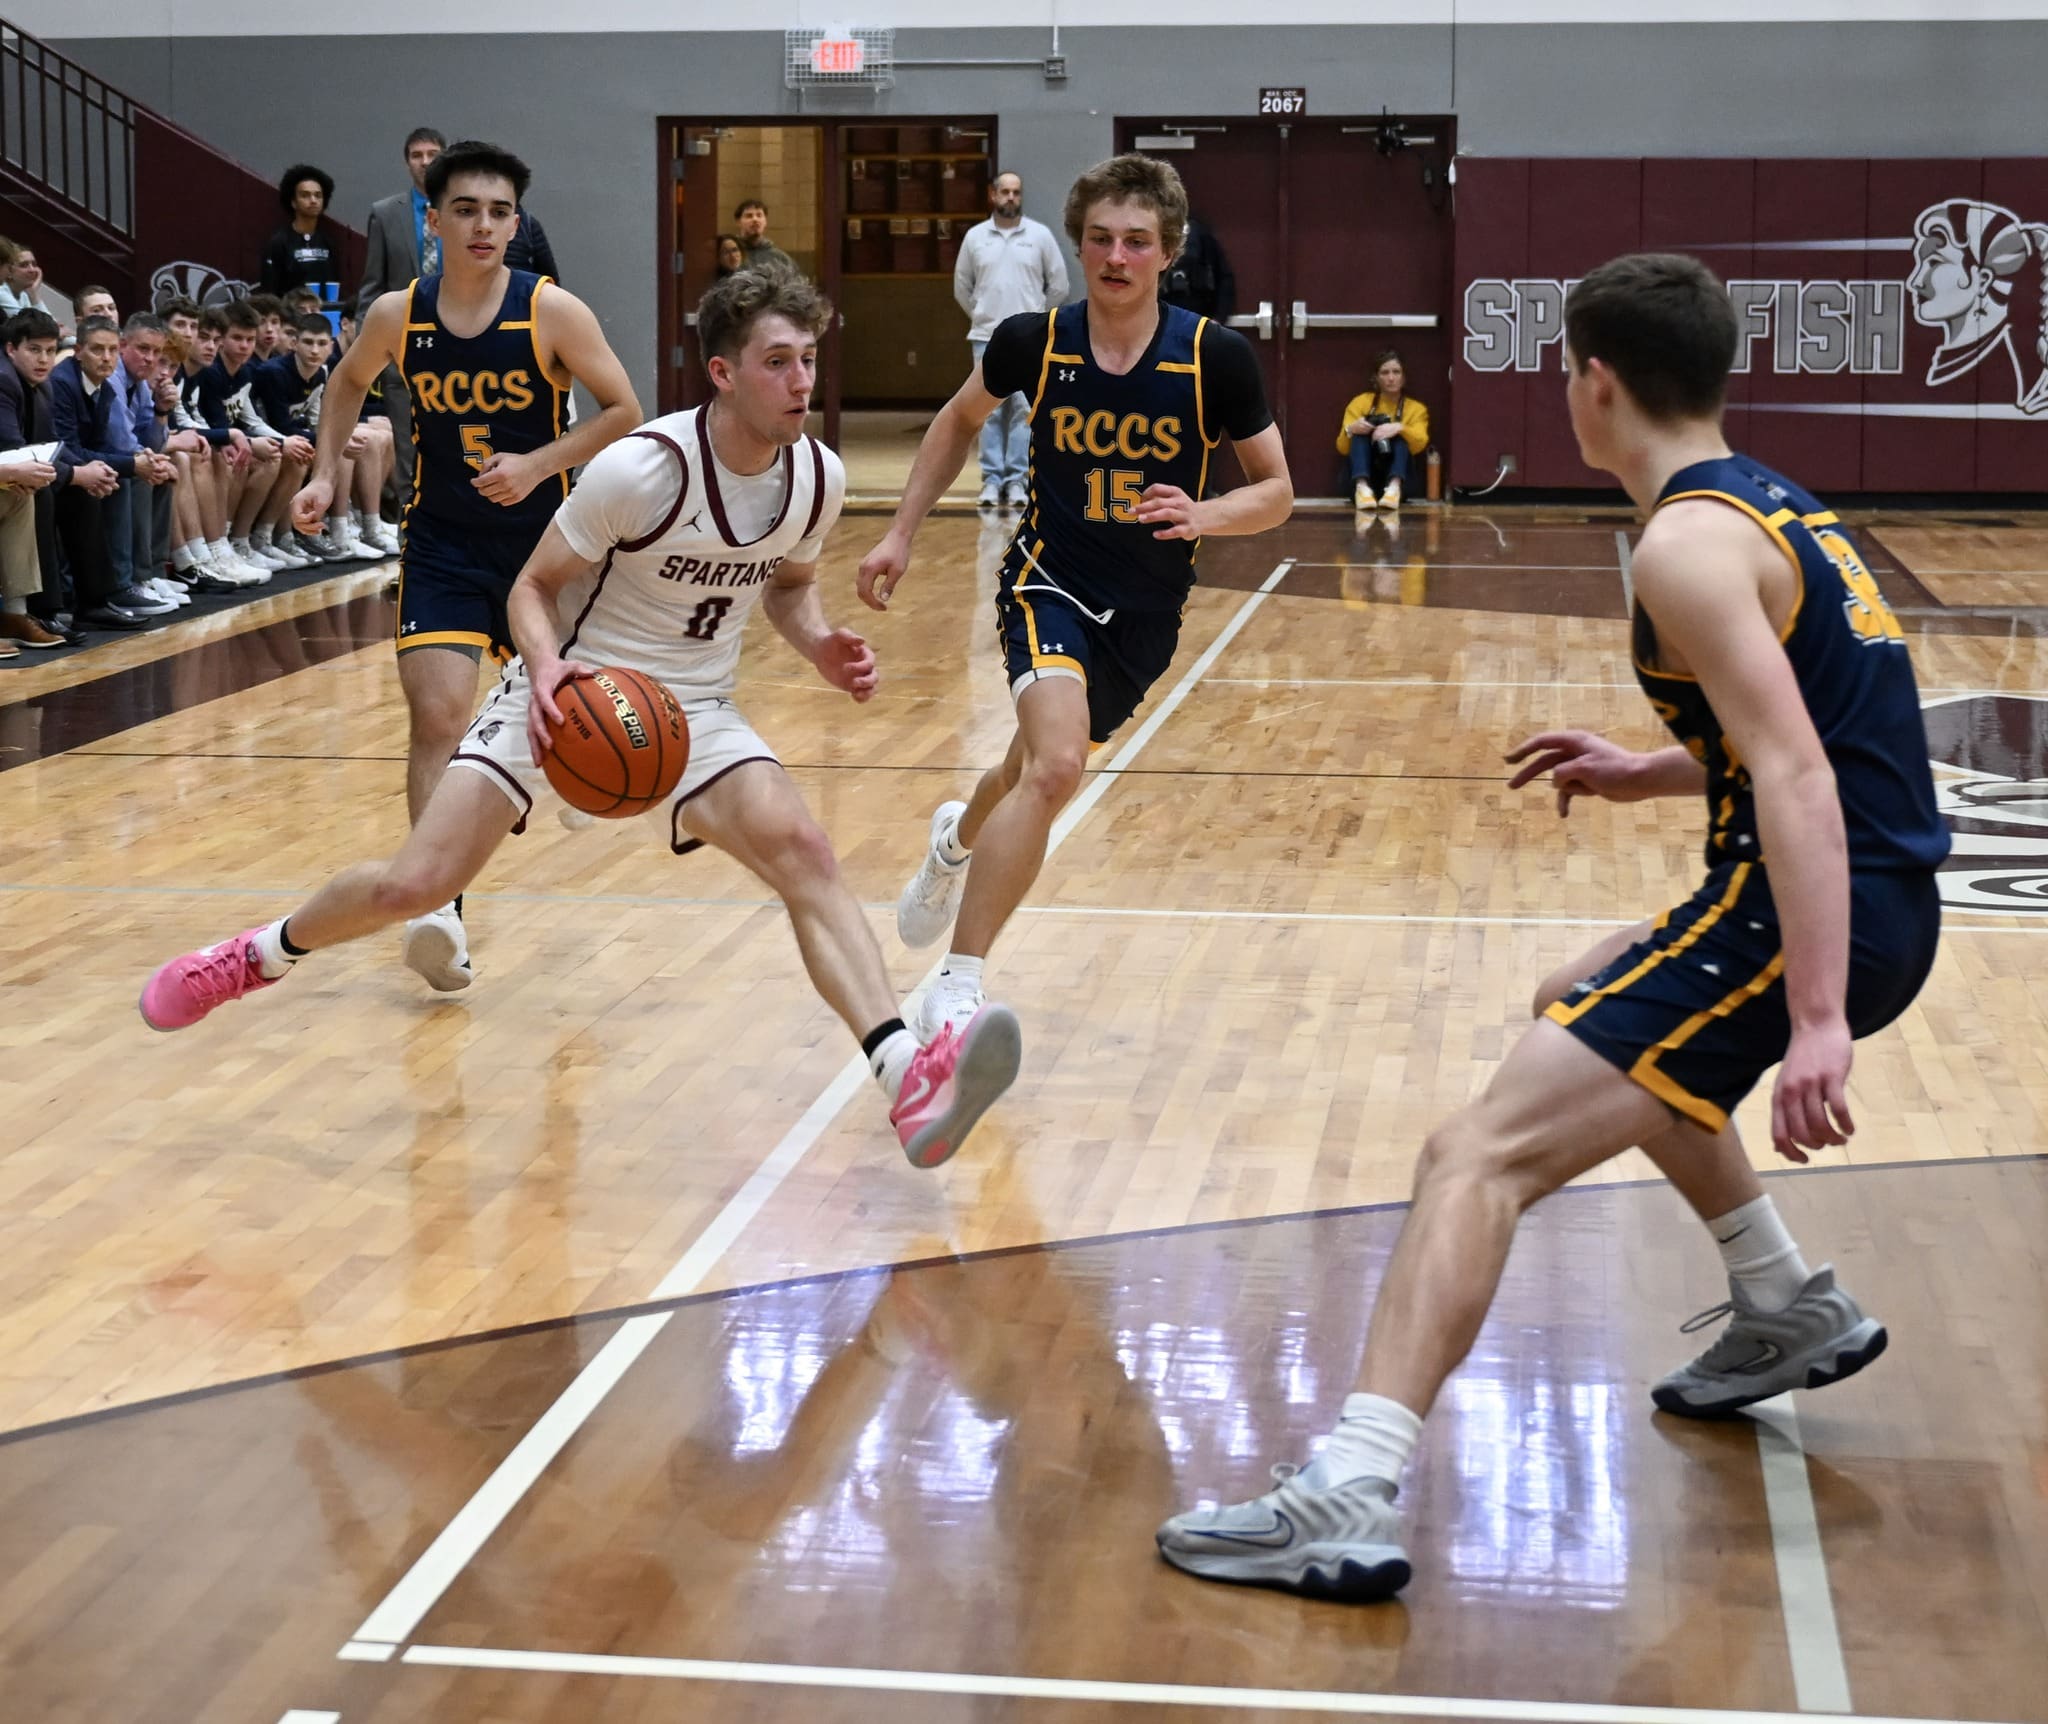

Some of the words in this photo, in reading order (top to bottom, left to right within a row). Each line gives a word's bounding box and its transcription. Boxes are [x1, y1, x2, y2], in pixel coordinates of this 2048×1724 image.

[820, 41, 856, 71] EXIT
[1262, 98, 1303, 113] 2067
[1464, 279, 1903, 374] SPFISH
[411, 369, 535, 415] RCCS
[459, 424, 494, 472] 5
[1050, 405, 1182, 462] RCCS
[1084, 468, 1144, 523] 15
[684, 596, 734, 640] 0
